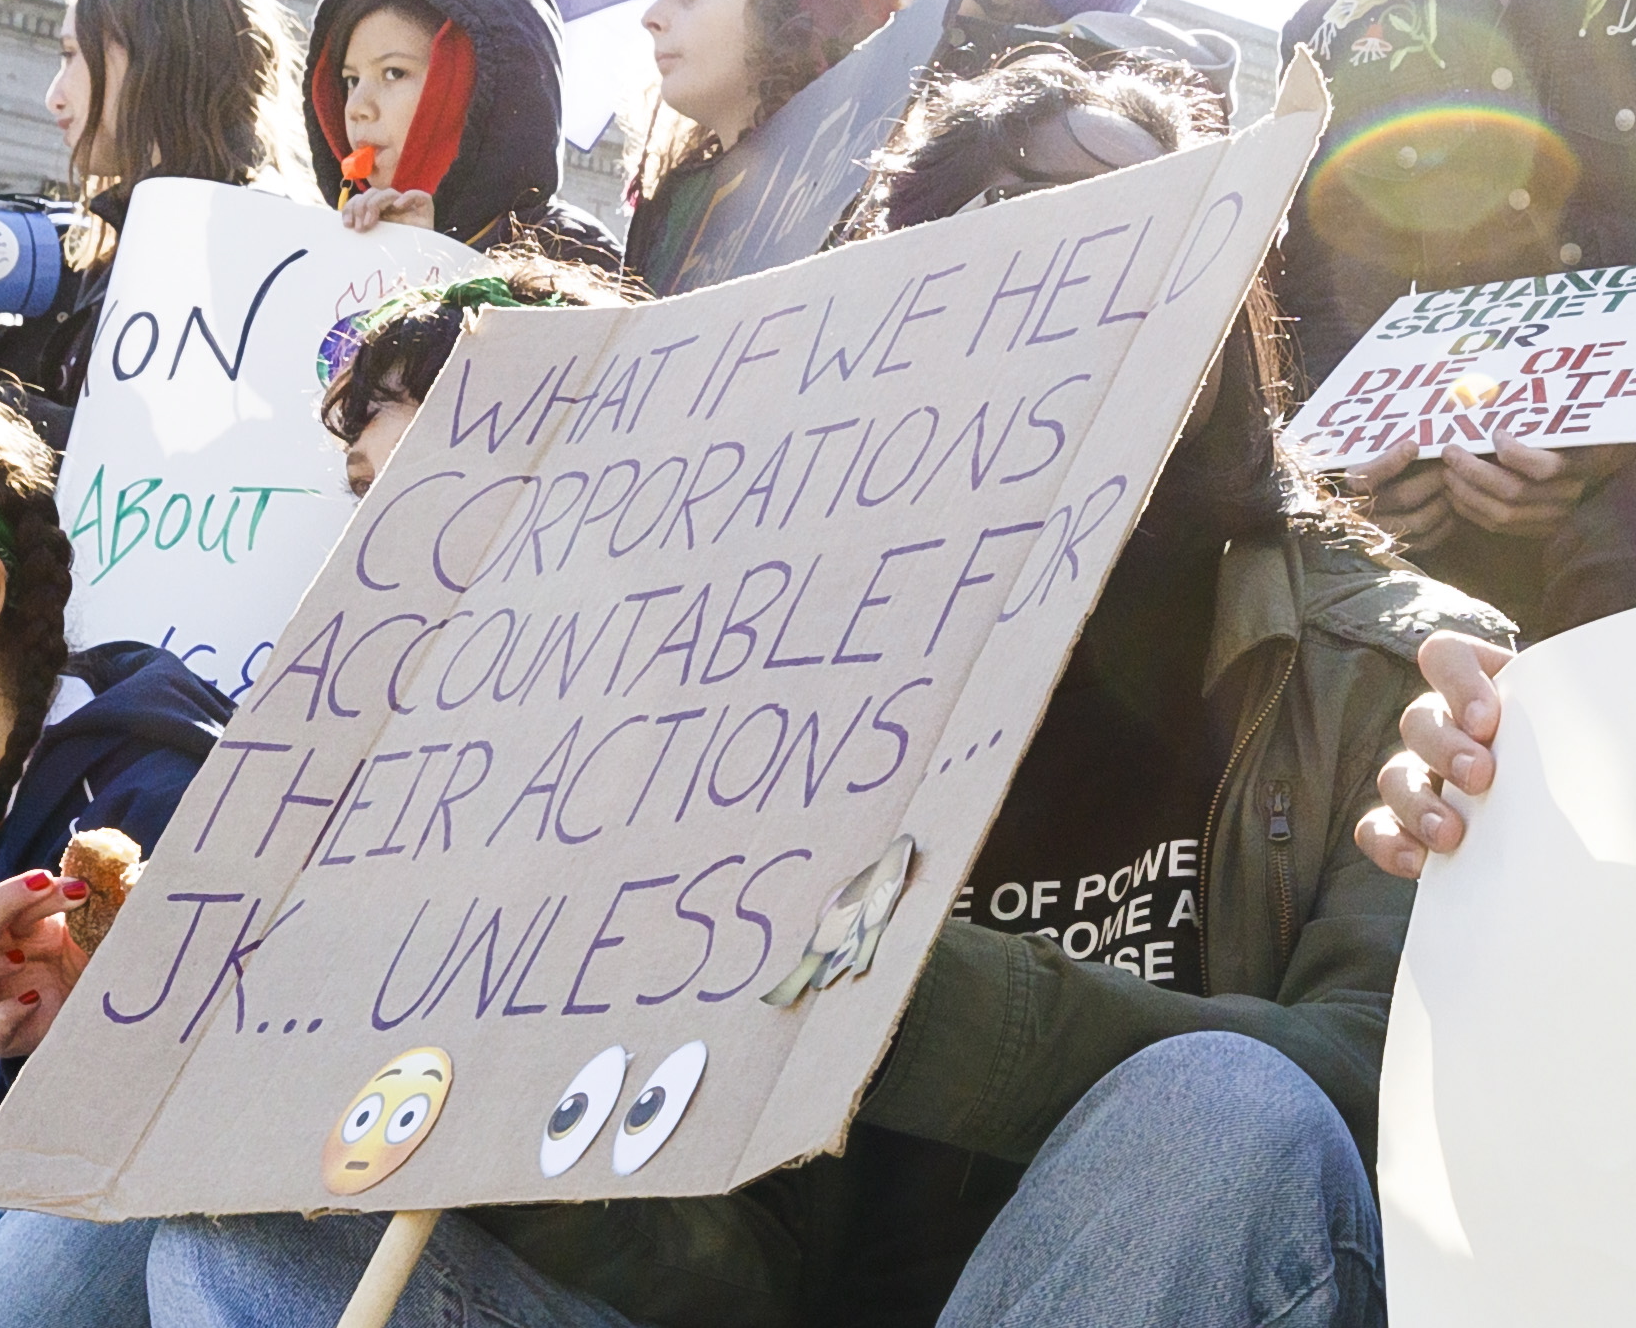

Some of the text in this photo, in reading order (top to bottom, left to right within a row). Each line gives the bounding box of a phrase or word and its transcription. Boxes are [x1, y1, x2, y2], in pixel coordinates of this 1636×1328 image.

[448, 191, 1245, 455] WHAT IF WE HELD
[1344, 340, 1628, 398] DIE OF
[1447, 322, 1551, 356] OR
[355, 373, 1093, 594] CORPORATIONS
[1300, 401, 1606, 457] CHANGE
[66, 463, 322, 587] ABOUT
[249, 536, 946, 723] ACCOUNTABLE
[926, 474, 1129, 659] FOR
[194, 676, 1005, 870] THEIR ACTIONS...
[101, 848, 813, 1044] JK... UNLESS
[989, 880, 1062, 921] OF
[1074, 839, 1199, 911] POWE
